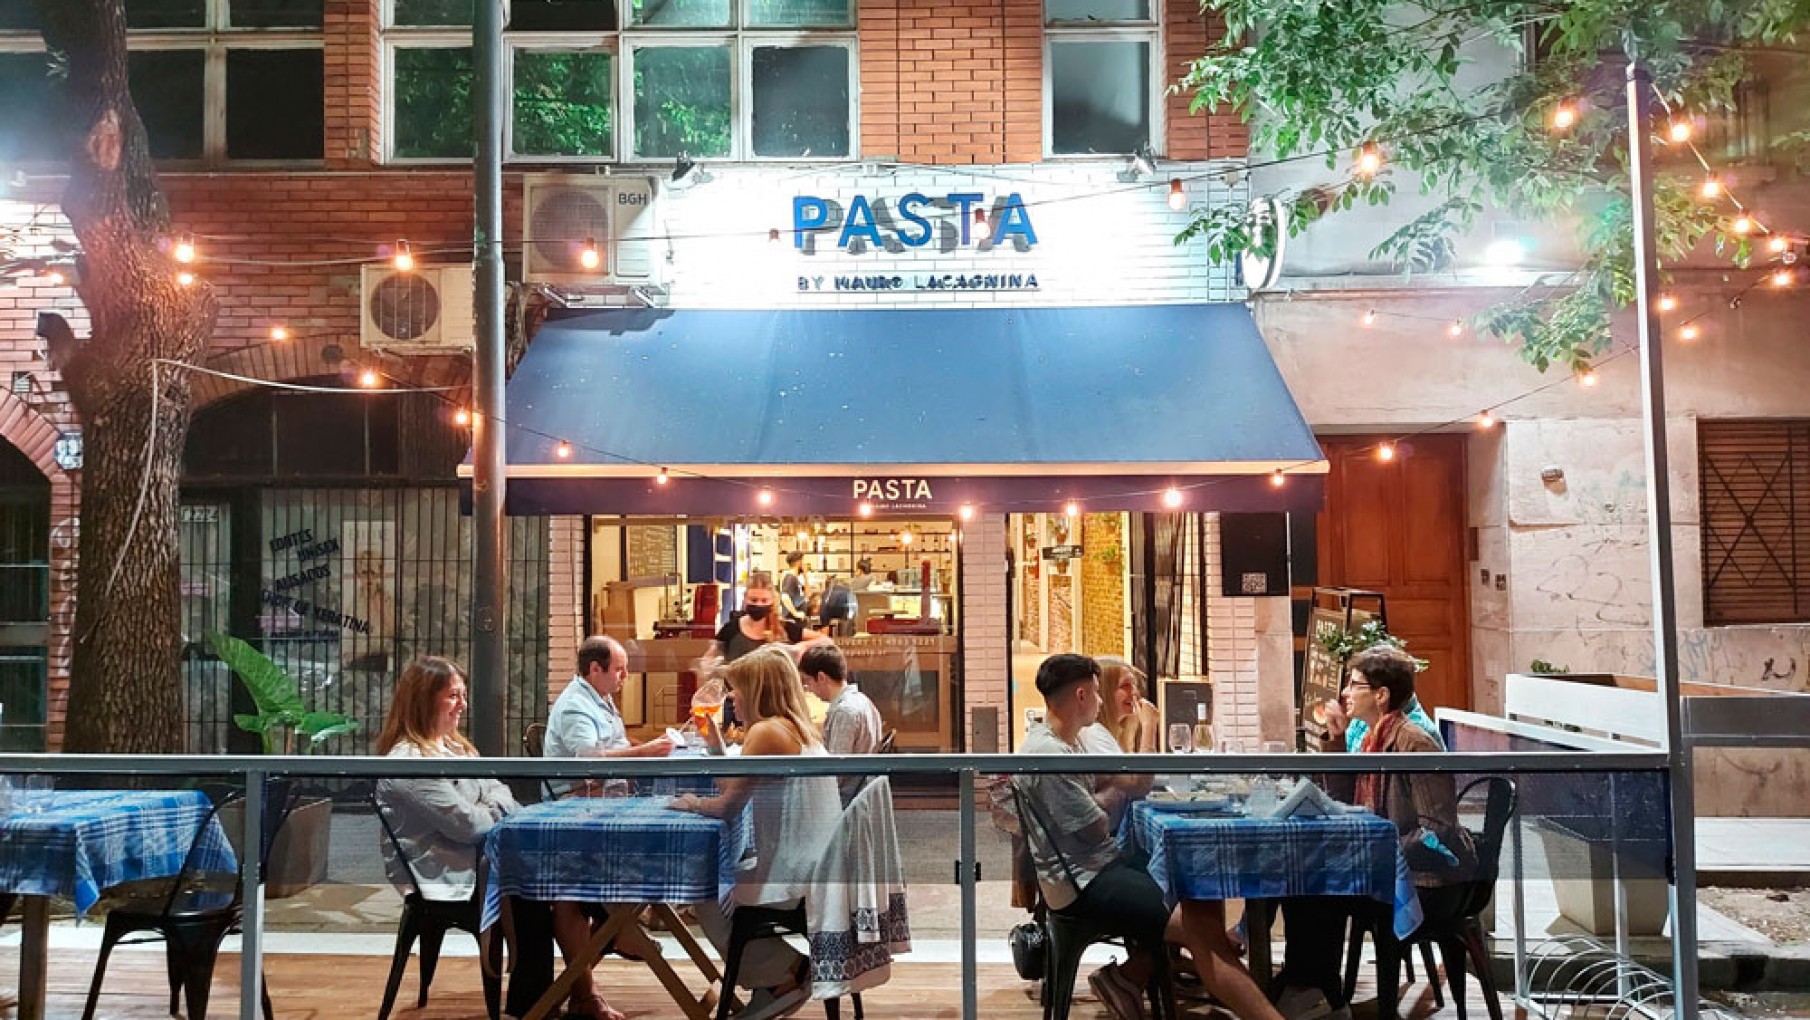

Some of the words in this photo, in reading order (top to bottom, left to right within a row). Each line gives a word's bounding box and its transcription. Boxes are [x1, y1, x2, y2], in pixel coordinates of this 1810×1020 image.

[618, 192, 648, 206] BGH
[793, 193, 1038, 248] PASTA
[797, 276, 825, 291] BY
[853, 479, 933, 500] PASTA
